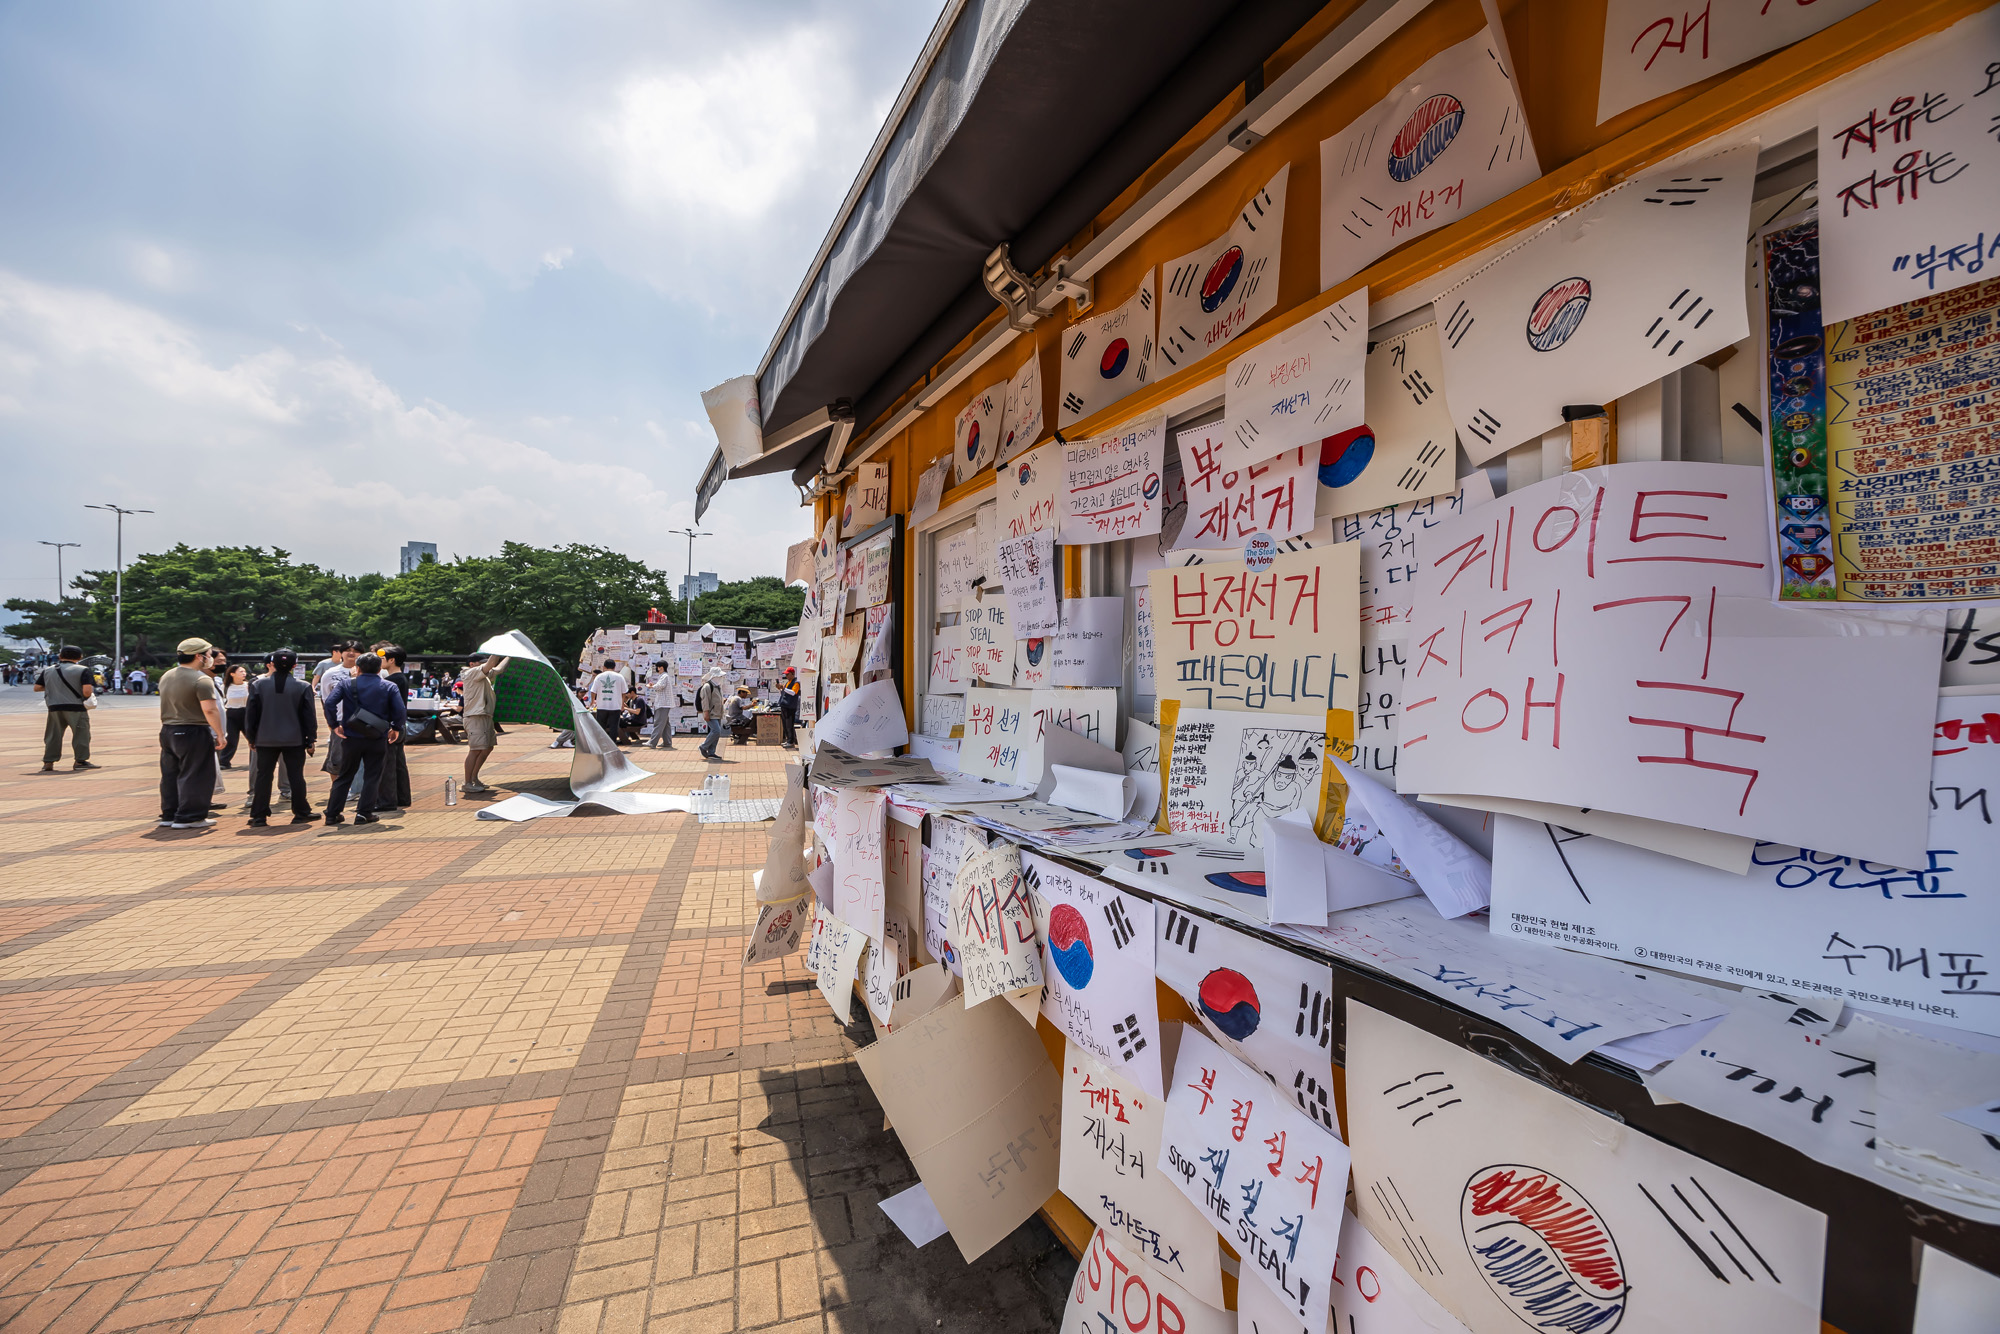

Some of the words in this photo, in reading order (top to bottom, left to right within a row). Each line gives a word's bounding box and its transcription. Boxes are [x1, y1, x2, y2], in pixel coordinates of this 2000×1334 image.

[1833, 92, 1964, 160] 자유는
[1836, 150, 1970, 217] 자유는
[1386, 179, 1465, 237] 재선거
[1101, 308, 1129, 335] 재선거
[1204, 302, 1247, 348] 재선거
[1832, 348, 1859, 365] 자유
[1864, 335, 1908, 358] 인류와
[1914, 326, 1942, 344] 세계
[1947, 311, 1991, 334] 국가들
[1268, 352, 1311, 388] 부정선거
[1270, 390, 1310, 416] 재선거
[1852, 414, 1895, 430] 보수는
[1938, 394, 1985, 413] 위에서
[1067, 446, 1099, 464] 미래의
[1101, 427, 1157, 455] 대한민국에게
[1069, 467, 1103, 487] 부끄럽지
[1104, 464, 1119, 484] 않은
[1122, 451, 1150, 475] 역사를
[1008, 493, 1055, 538] 재선거
[1070, 492, 1105, 515] 가르치고
[1109, 482, 1141, 507] 싶습니다
[1194, 476, 1295, 542] 재선거
[1858, 532, 1883, 542] 태아
[1958, 523, 1984, 532] 선생
[1890, 517, 1919, 529] 부모
[1930, 512, 1959, 525] 선생
[1246, 548, 1258, 556] The
[1260, 548, 1274, 557] Steal
[1246, 556, 1257, 565] My
[1258, 555, 1274, 565] Vote
[1252, 539, 1269, 549] Stop
[1864, 582, 1885, 591] 세계
[1901, 589, 1925, 598] 세계
[965, 608, 982, 623] STOP
[988, 607, 1005, 625] THE
[1171, 565, 1320, 650] 부정선거
[970, 627, 995, 644] STEAL
[1416, 585, 1717, 680] 지키기
[966, 646, 981, 657] STOP
[987, 648, 1004, 663] THE
[972, 662, 990, 676] STEAL
[1177, 652, 1348, 710] 팩트입니다
[968, 703, 994, 736] 부정
[997, 708, 1020, 735] 선거
[986, 744, 1020, 772] 재선거
[1461, 672, 1767, 817] 애국
[1189, 821, 1225, 834] 수개표!
[1511, 912, 1547, 927] 대한민국
[1550, 917, 1568, 931] 헌법
[1571, 921, 1597, 935] 제1조
[1524, 926, 1561, 941] 대한민국은
[1563, 932, 1620, 951] 민주공화국이다.
[1649, 950, 1694, 966] 대한민국의
[1696, 956, 1723, 973] 주권은
[1725, 962, 1764, 981] 국민에게
[1766, 970, 1788, 986] 있고,
[1790, 975, 1844, 997] 모든권력은
[1846, 987, 1915, 1012] 국민으로부터
[1917, 1001, 1959, 1019] 나온다.
[1082, 1115, 1144, 1179] 재선거
[1168, 1145, 1196, 1187] STOP
[1203, 1177, 1231, 1224] THE
[1236, 1219, 1311, 1317] STEAL!
[1087, 1228, 1187, 1334] STOP
